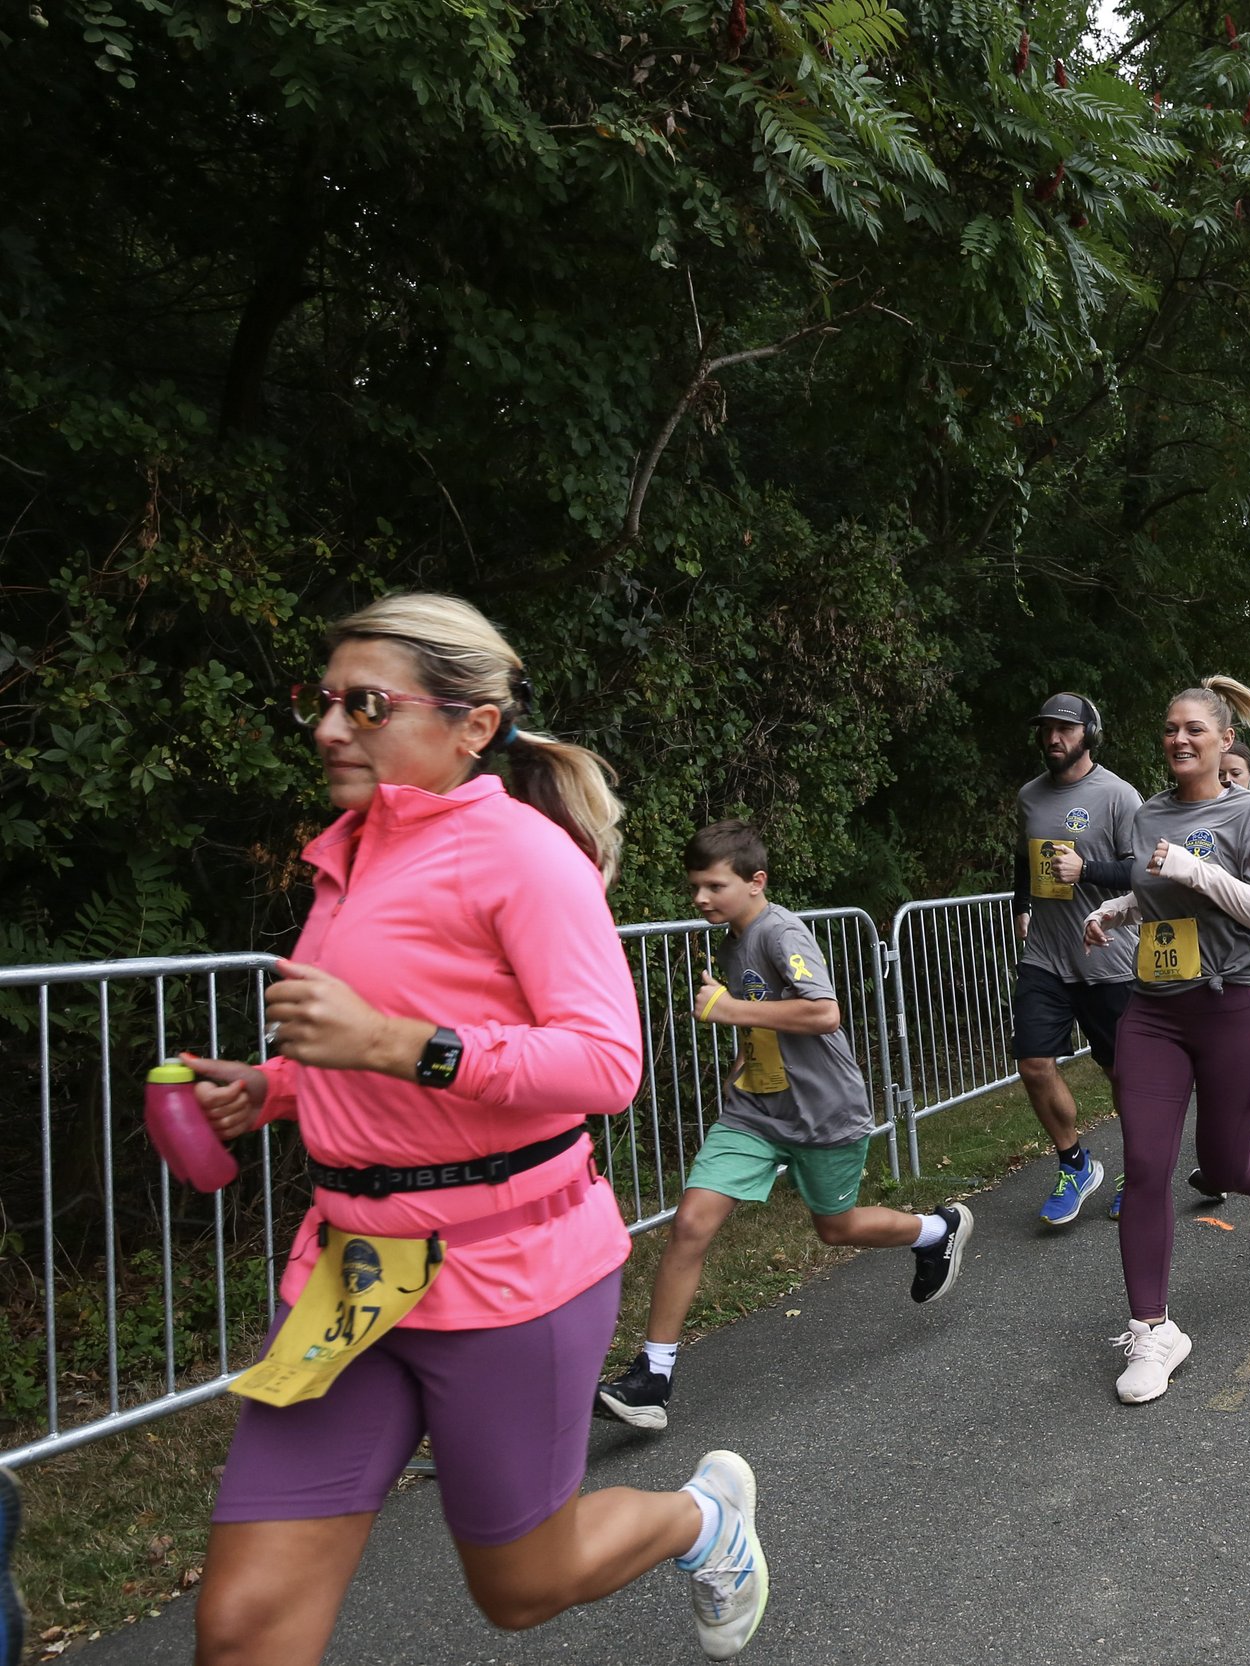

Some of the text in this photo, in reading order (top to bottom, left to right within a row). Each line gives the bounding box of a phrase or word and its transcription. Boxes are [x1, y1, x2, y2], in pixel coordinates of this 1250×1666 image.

[1040, 861, 1052, 875] 12
[1154, 949, 1178, 968] 216
[943, 1232, 956, 1260] HOKA
[324, 1300, 382, 1347] 347
